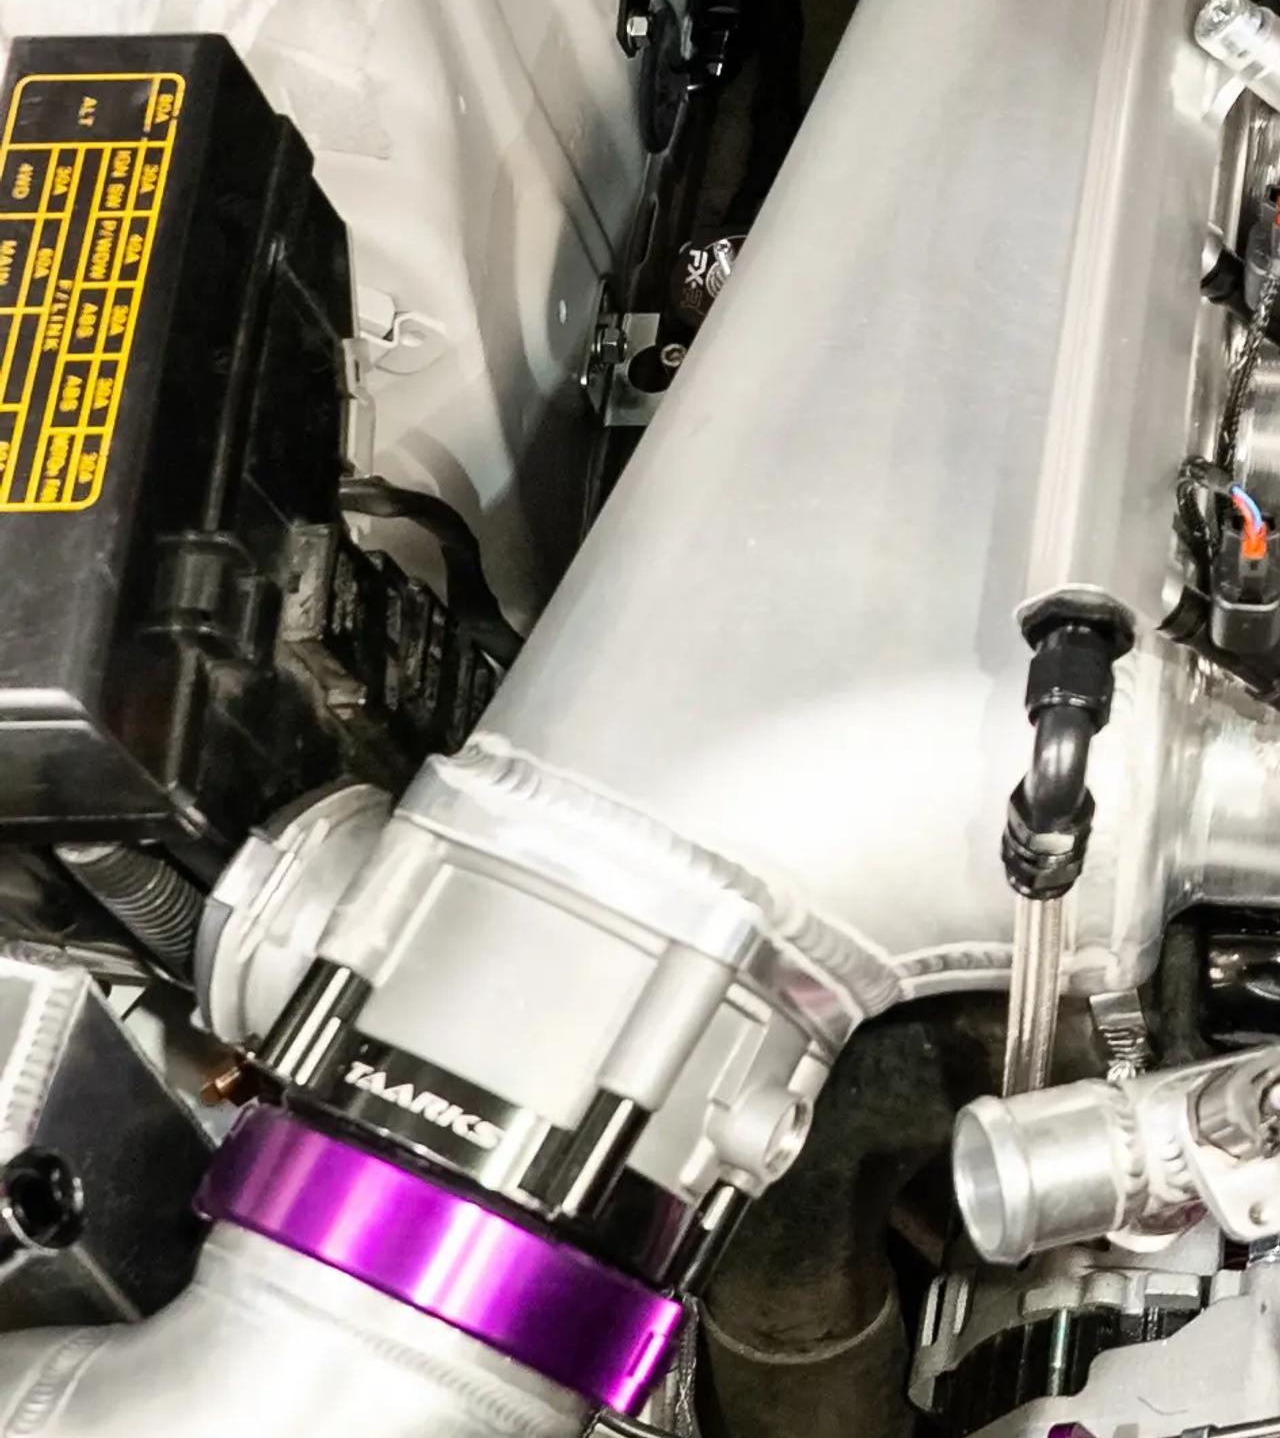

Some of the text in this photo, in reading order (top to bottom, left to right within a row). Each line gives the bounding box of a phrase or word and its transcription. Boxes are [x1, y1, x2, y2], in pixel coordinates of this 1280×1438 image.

[78, 95, 98, 127] ALT
[11, 162, 35, 200] 4WD
[110, 149, 132, 178] IGN
[42, 279, 74, 353] F/LINK
[76, 302, 100, 340] ABS
[59, 375, 83, 413] ABS
[345, 1061, 506, 1150] TAARKS
